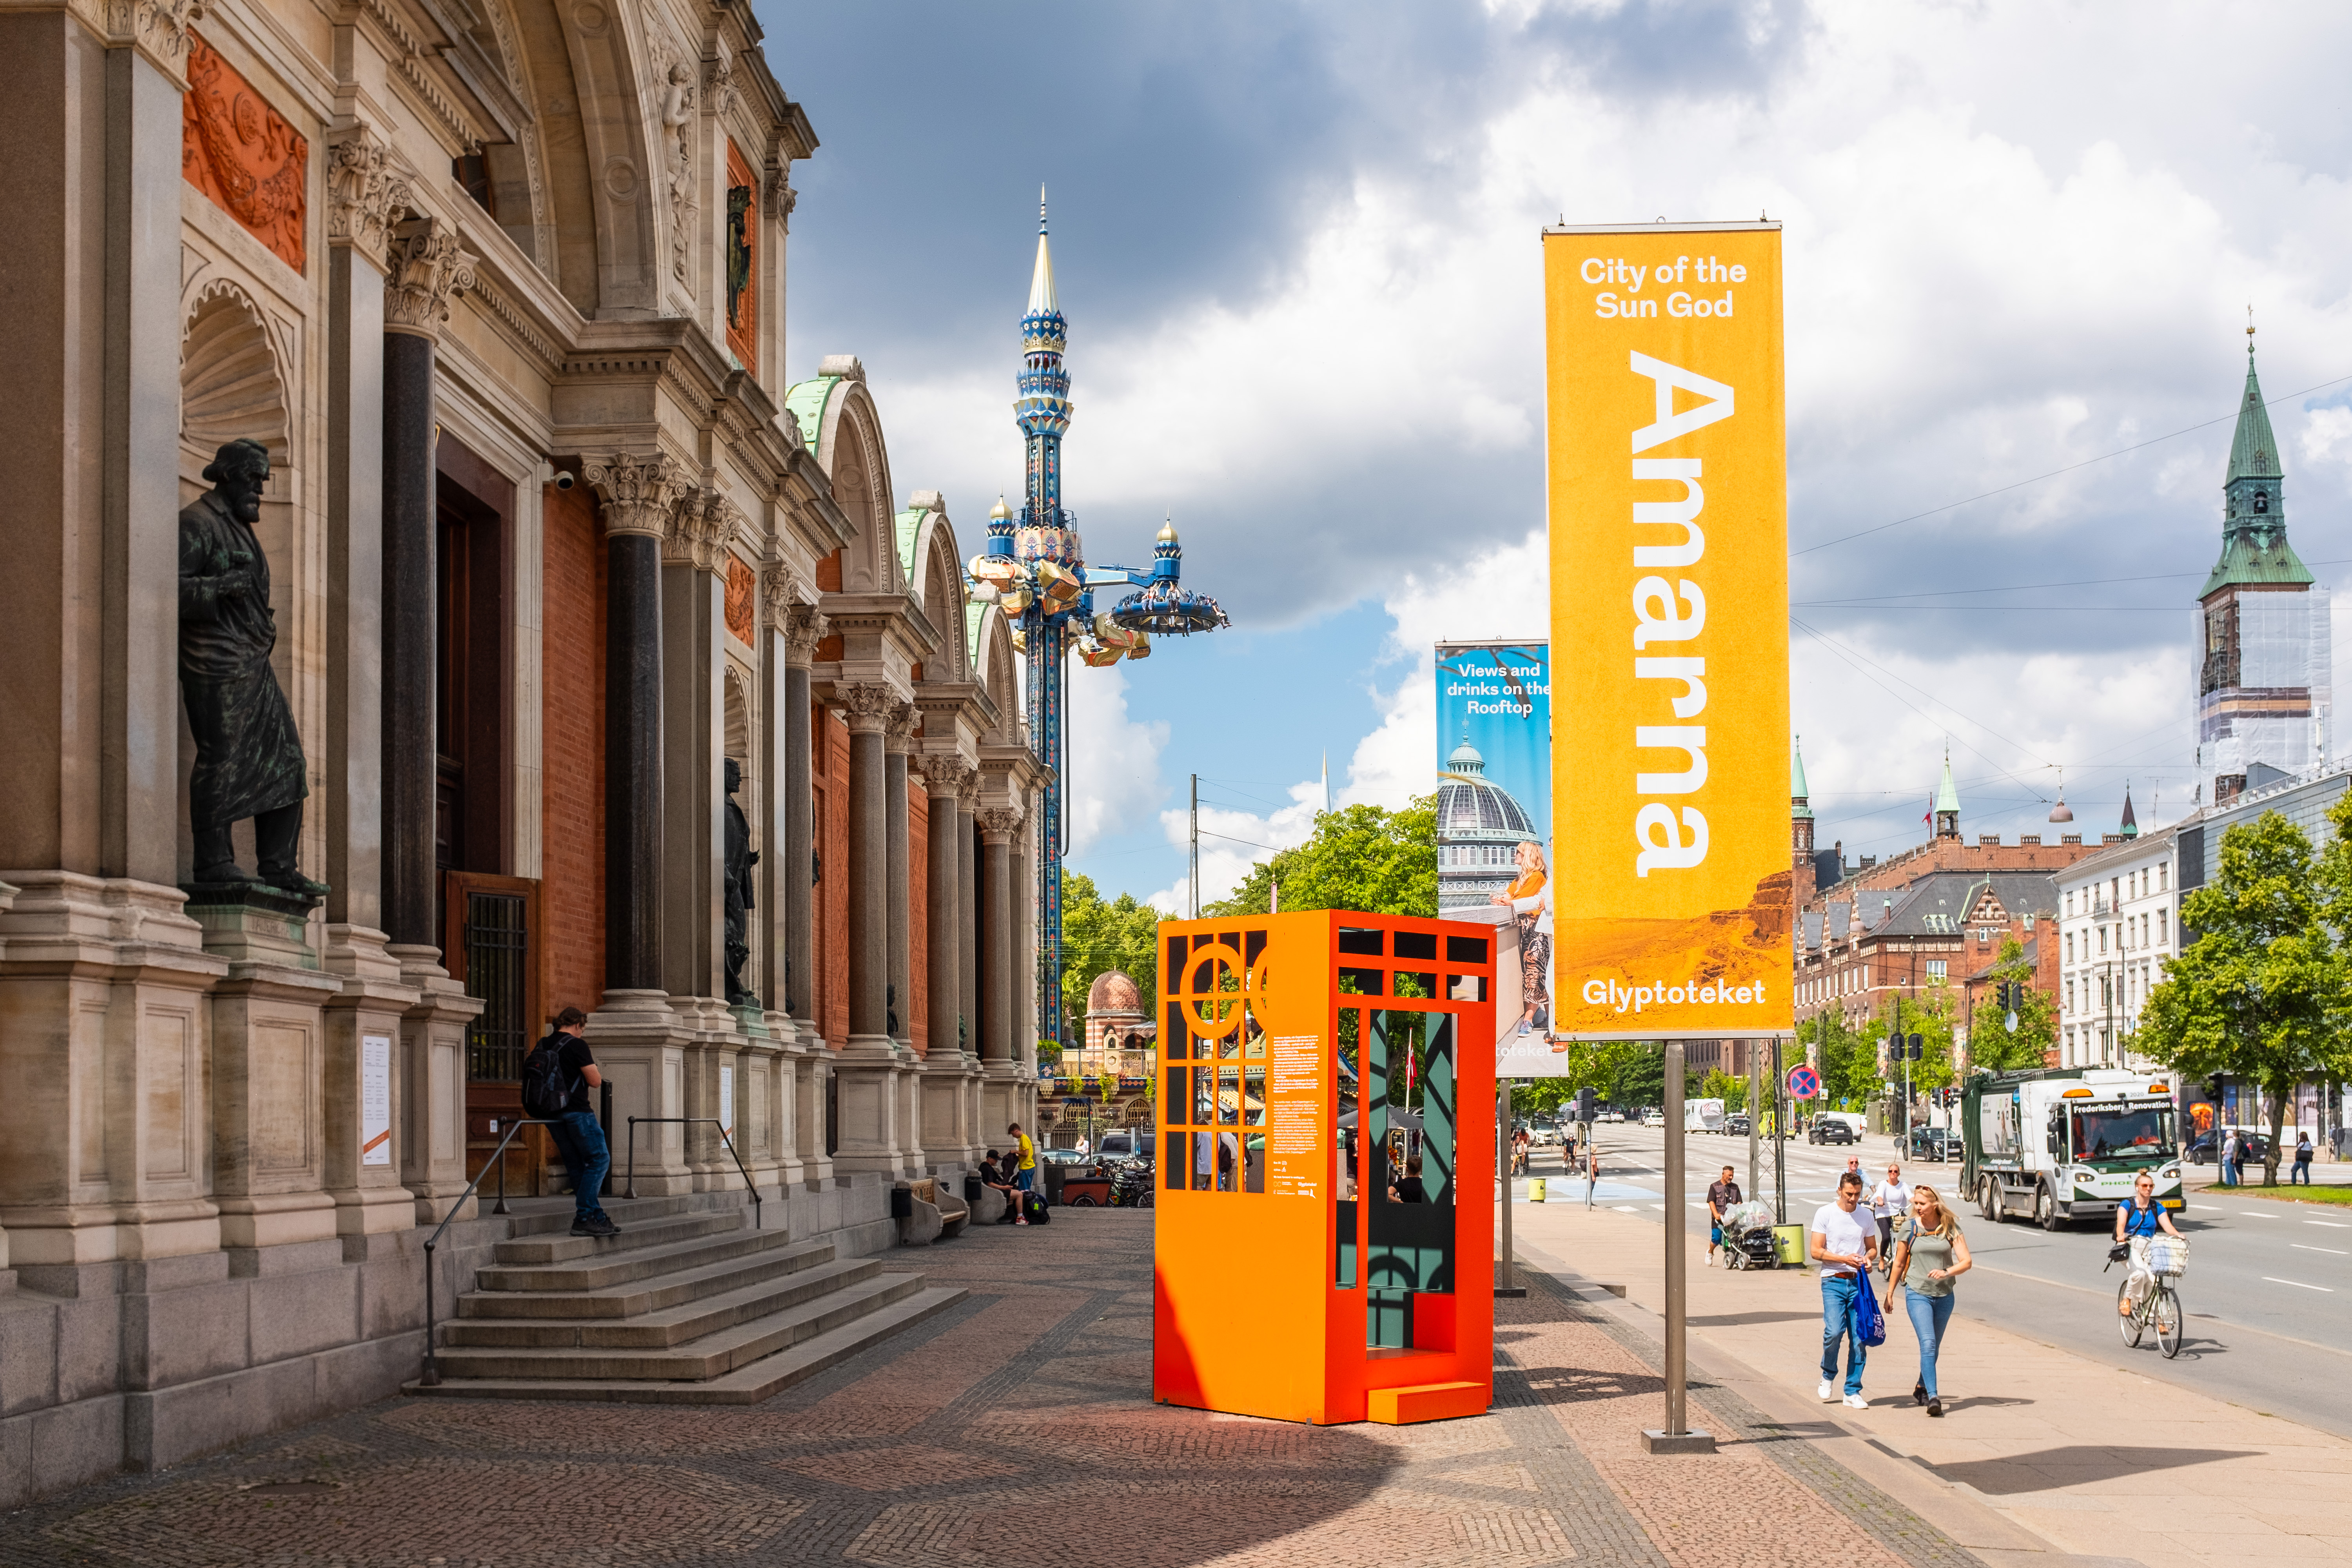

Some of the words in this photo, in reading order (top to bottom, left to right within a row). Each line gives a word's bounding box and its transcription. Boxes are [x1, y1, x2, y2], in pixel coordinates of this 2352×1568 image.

[1581, 258, 1646, 293] City
[1655, 256, 1689, 283] of
[1695, 256, 1747, 282] the
[1595, 292, 1657, 318] Sun
[1667, 290, 1732, 318] God
[1630, 350, 1734, 877] Amarna
[1458, 663, 1507, 677] Views
[1511, 662, 1540, 677] and
[1447, 682, 1499, 696] drinks
[1503, 686, 1522, 695] on
[1526, 681, 1549, 695] the
[1468, 699, 1533, 718] Rooftop
[1583, 978, 1765, 1012] Glyptoteket
[1496, 1043, 1552, 1057] toteket
[2128, 1101, 2170, 1110] Renovation
